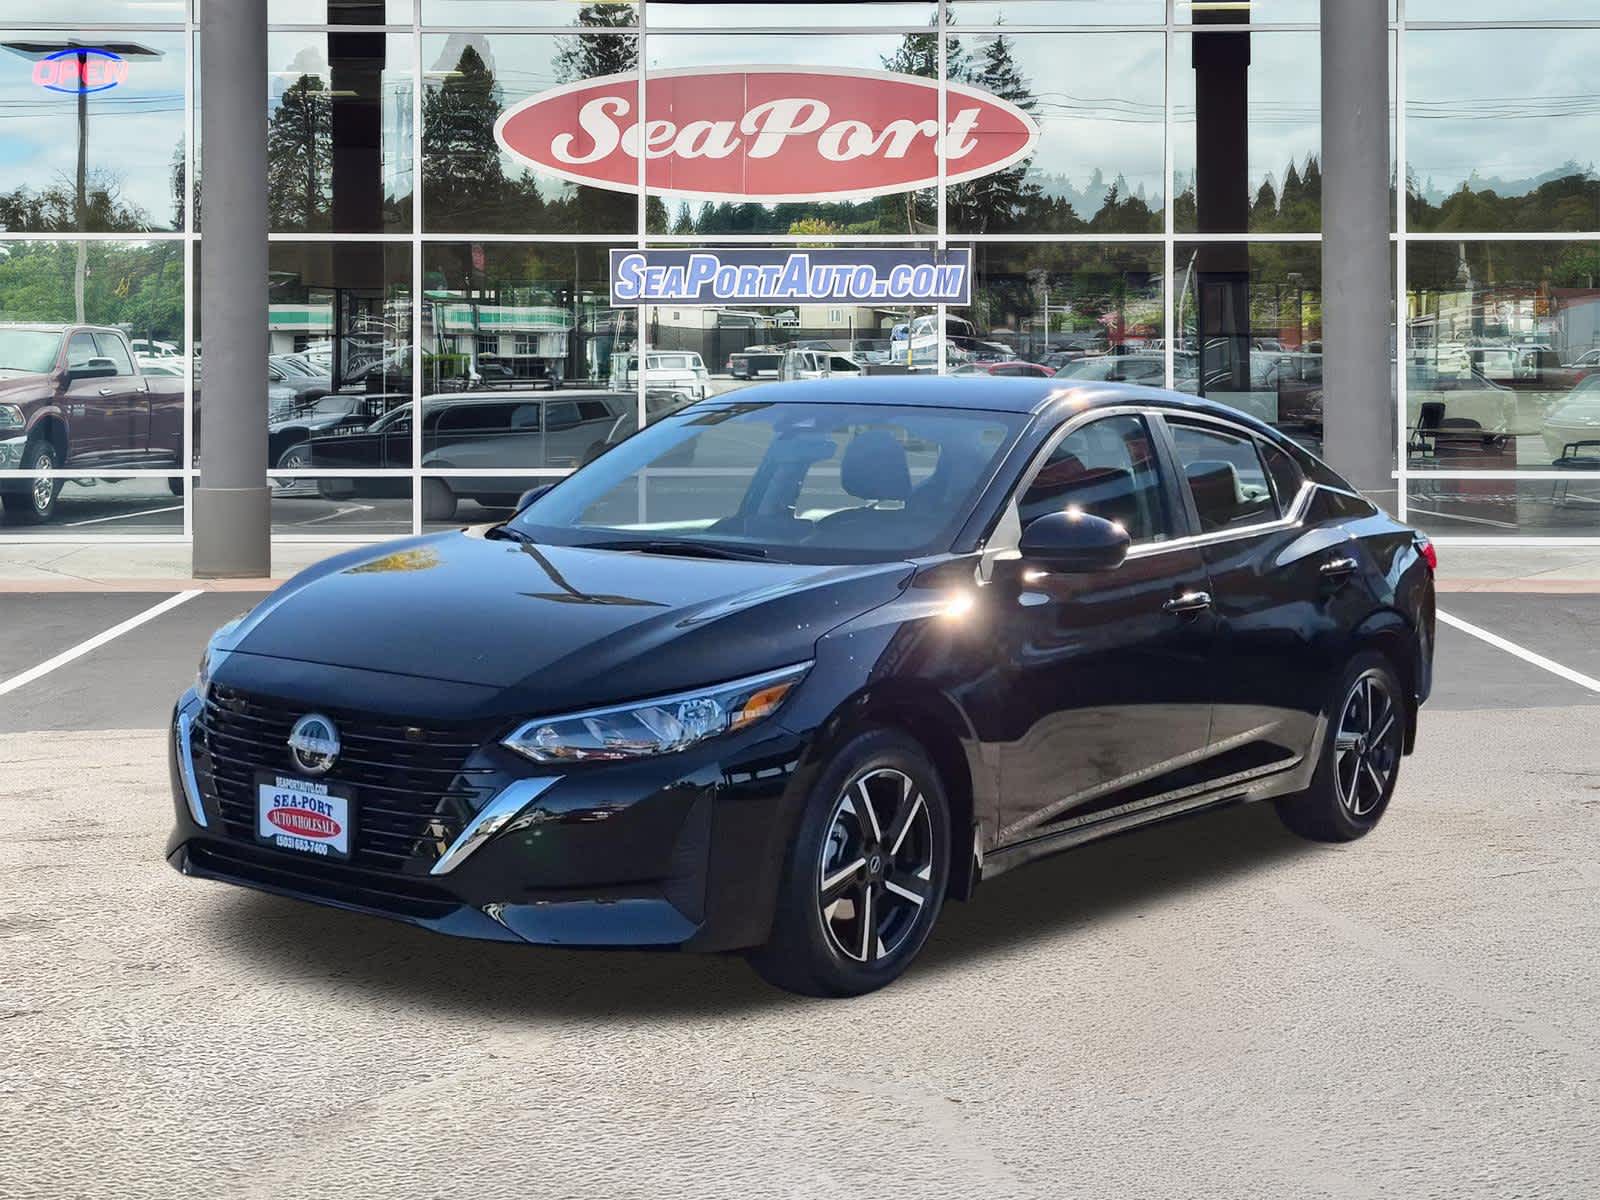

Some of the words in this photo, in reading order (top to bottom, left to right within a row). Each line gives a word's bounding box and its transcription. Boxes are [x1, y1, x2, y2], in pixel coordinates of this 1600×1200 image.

[32, 60, 128, 86] OPEN
[550, 96, 981, 164] SeaPort
[272, 810, 291, 827] AUTO
[292, 815, 336, 834] WHOLESALE
